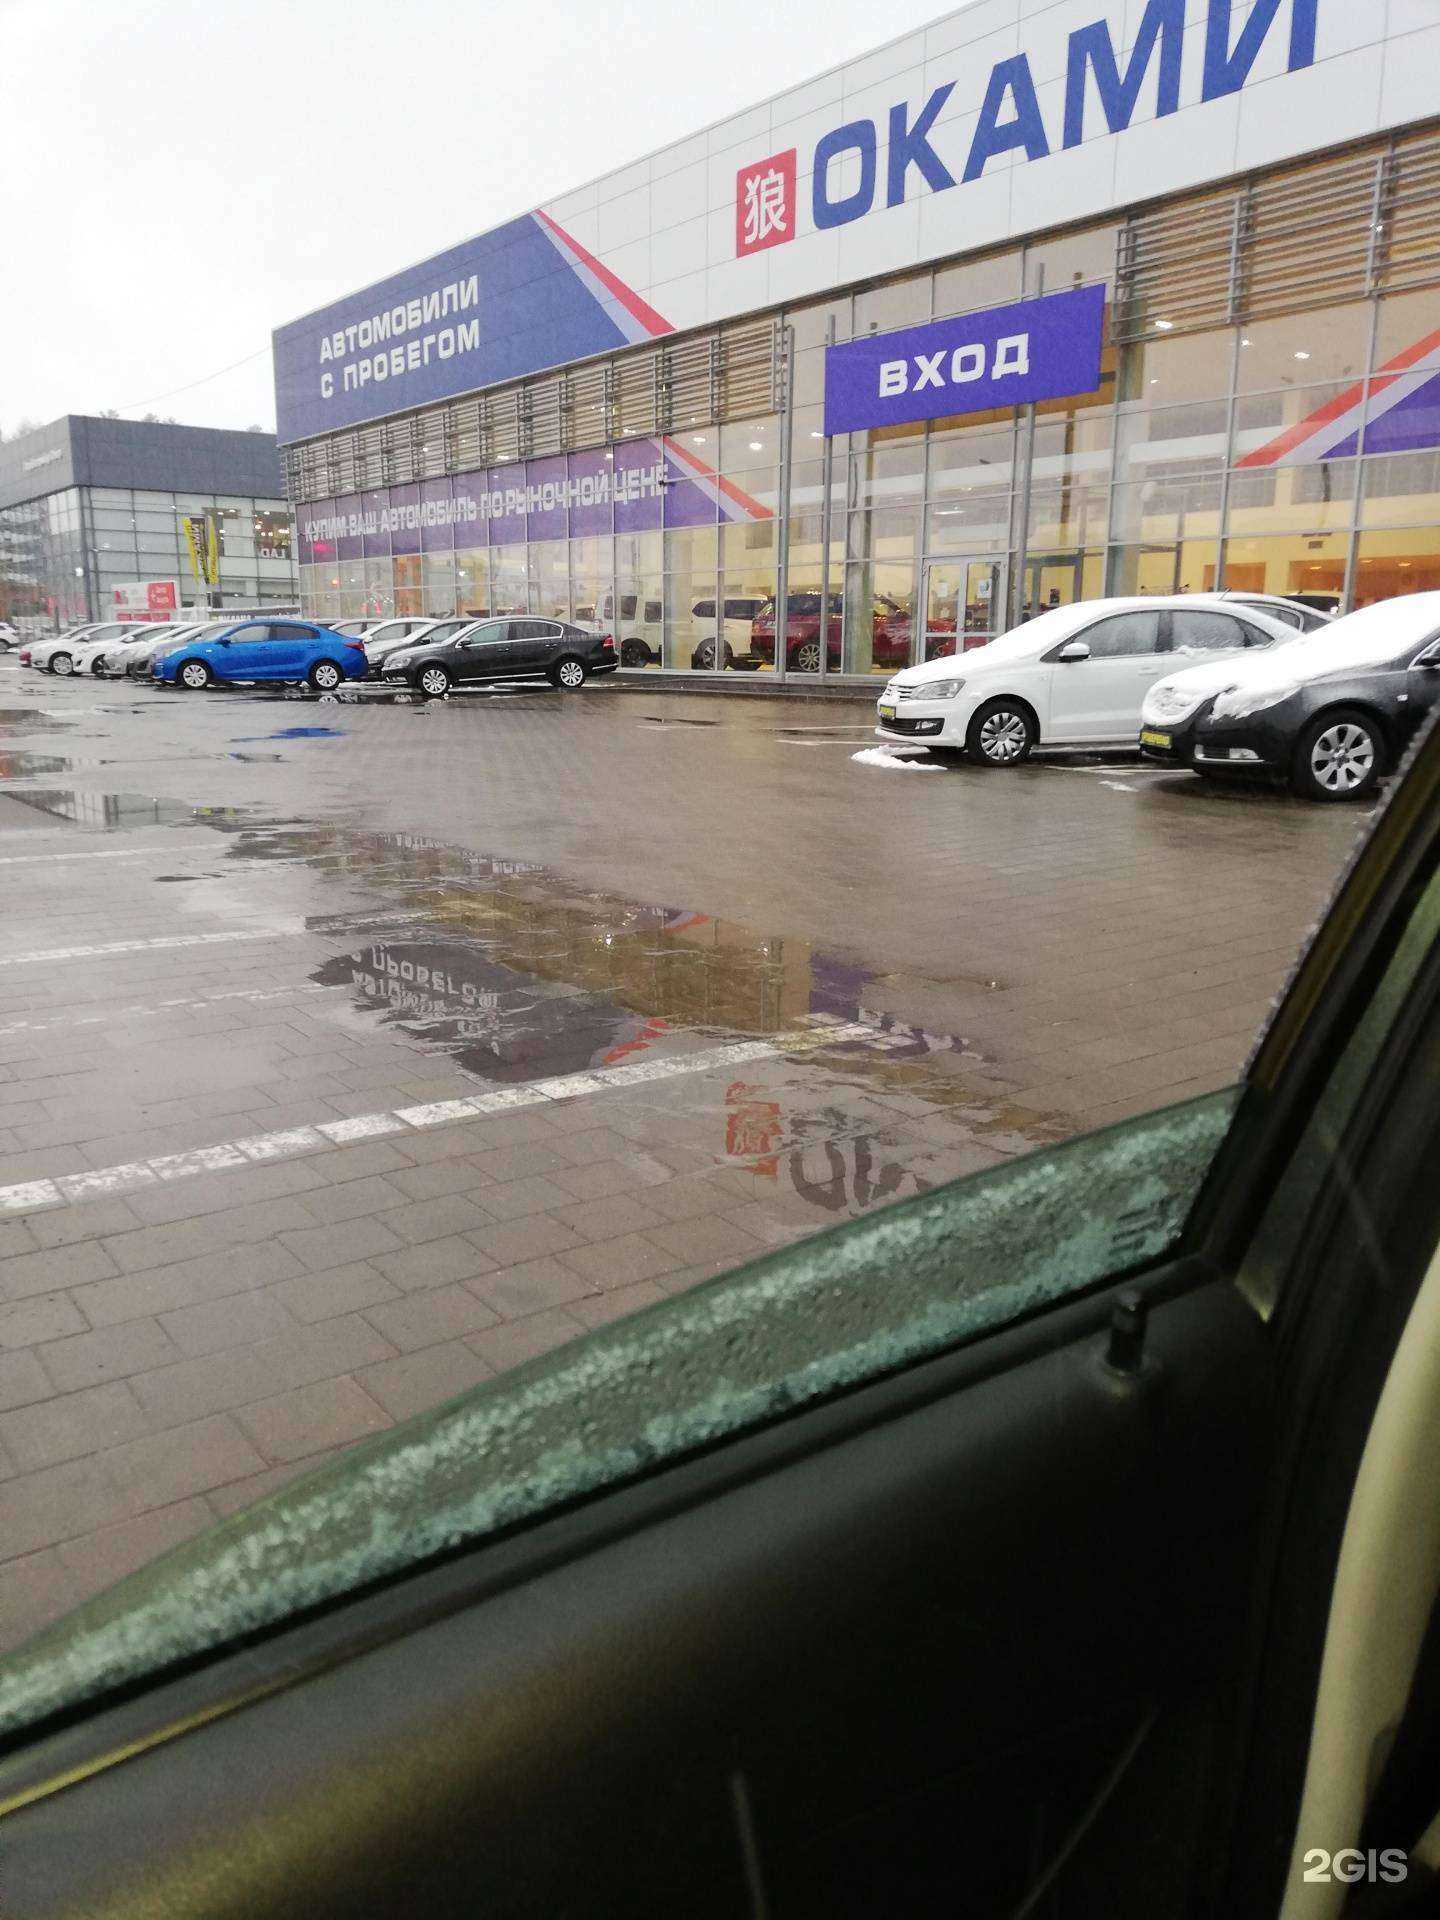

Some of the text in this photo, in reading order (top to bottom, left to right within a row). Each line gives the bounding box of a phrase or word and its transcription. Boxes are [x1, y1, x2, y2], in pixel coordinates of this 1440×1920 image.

[812, 0, 1317, 231] ОКАМИ
[744, 167, 787, 244] 狼
[319, 274, 479, 364] АВТОМОБИЛИ
[320, 318, 480, 399] С ПРОБЕГОМ
[879, 333, 1030, 398] ВХОД
[304, 460, 669, 543] КУПИМ ВАШ АВТОМОБИЛЬ ПО РЫНОЧНОЙ ЦЕНЕ
